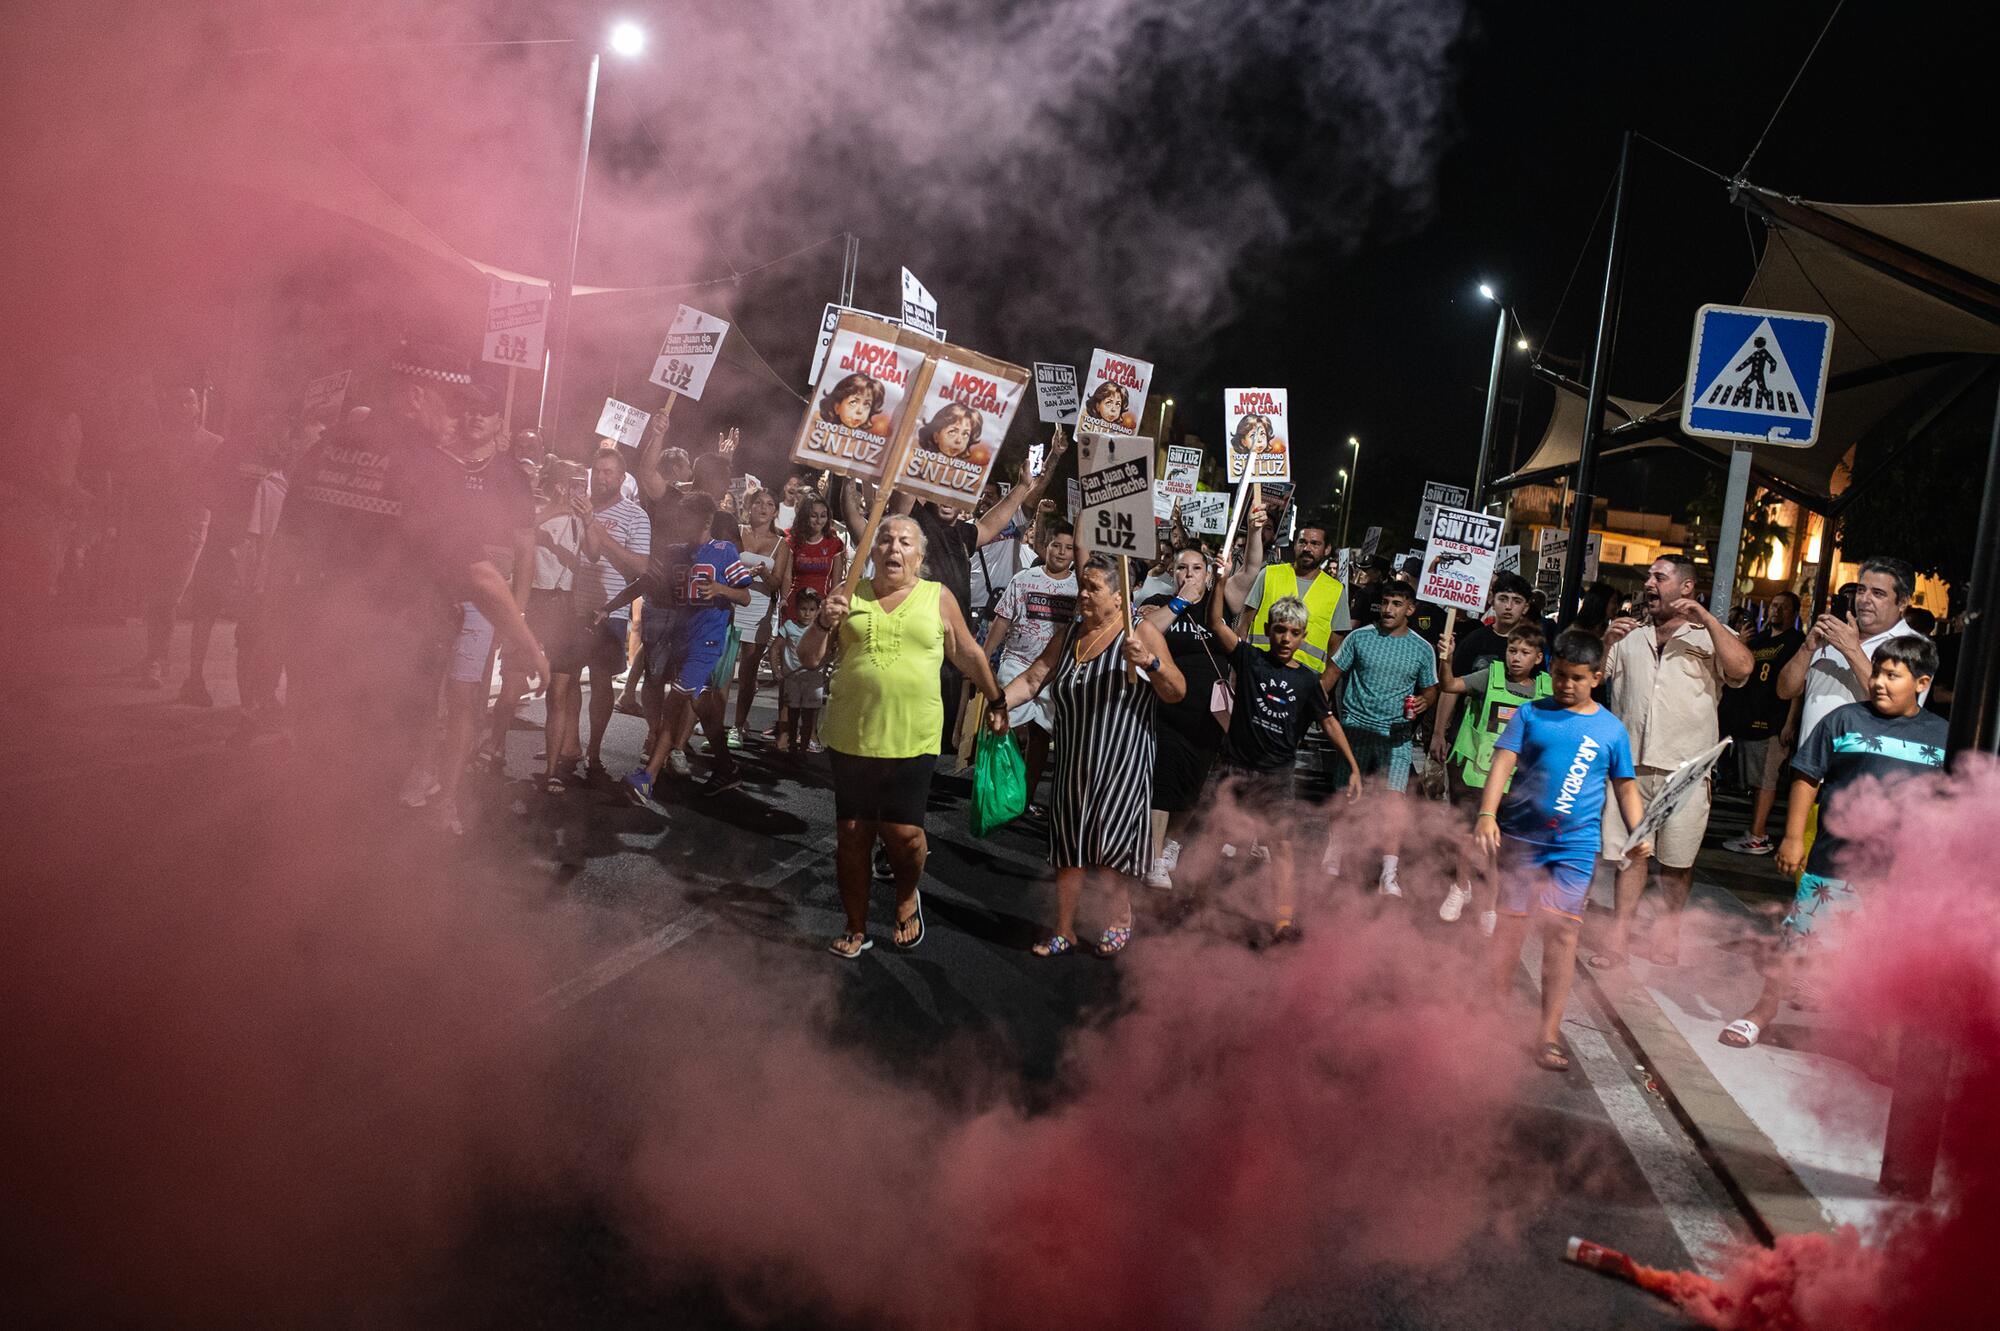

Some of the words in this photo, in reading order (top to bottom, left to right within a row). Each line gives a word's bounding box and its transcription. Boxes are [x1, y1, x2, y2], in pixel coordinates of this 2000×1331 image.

[664, 343, 714, 354] Aznalfarache
[667, 335, 682, 345] San
[683, 334, 701, 344] Juan
[702, 333, 711, 342] de
[494, 345, 527, 363] LUZ
[852, 340, 898, 370] MOYA
[840, 355, 855, 372] DA
[857, 358, 872, 376] LA
[873, 364, 909, 388] CARA!
[1039, 369, 1054, 382] SIN
[1055, 371, 1074, 384] LUZ
[1105, 358, 1137, 379] MOYA
[660, 369, 692, 391] LUZ
[952, 371, 998, 401] MOYA
[1097, 368, 1107, 380] DA
[1108, 371, 1120, 384] LA
[1119, 375, 1144, 393] CARA!
[617, 403, 627, 412] UN
[939, 385, 955, 401] DA
[954, 389, 970, 407] LA
[971, 396, 1008, 418] CARA!
[1234, 405, 1245, 415] DA
[1246, 405, 1257, 415] LA
[1258, 402, 1282, 417] CARA!
[1240, 392, 1273, 405] MOYA
[815, 420, 838, 433] TODO
[839, 426, 851, 436] EL
[851, 428, 886, 446] VERANO
[1084, 415, 1101, 426] TODO
[1110, 422, 1133, 436] VERANO
[808, 430, 841, 455] SIN
[842, 437, 883, 464] LUZ
[1169, 451, 1183, 463] SIN
[1184, 453, 1200, 465] LUZ
[913, 447, 937, 461] TODO
[937, 455, 949, 464] EL
[949, 456, 983, 475] VERANO
[1259, 460, 1285, 476] LUZ
[906, 456, 939, 482] SIN
[939, 466, 980, 493] LUZ
[1083, 476, 1101, 491] San
[1102, 467, 1126, 485] Juan
[1125, 463, 1139, 476] de
[1085, 476, 1147, 507] Aznalfarache
[1426, 488, 1444, 502] SIN
[1444, 491, 1465, 507] LUZ
[1449, 512, 1468, 523] SANTA
[1469, 516, 1490, 526] ISABEL
[1095, 527, 1136, 551] LUZ
[1436, 517, 1464, 541] SIN
[1464, 523, 1498, 549] LUZ
[1434, 538, 1444, 546] LA
[1445, 541, 1458, 549] LUZ
[1459, 544, 1469, 552] ES
[1423, 584, 1481, 607] MATARNOS!
[1429, 575, 1462, 591] DEJAD
[1465, 583, 1480, 595] DE
[1759, 662, 1771, 682] 8
[1259, 678, 1297, 702] PARIS
[1256, 697, 1289, 719] BROOKLYN
